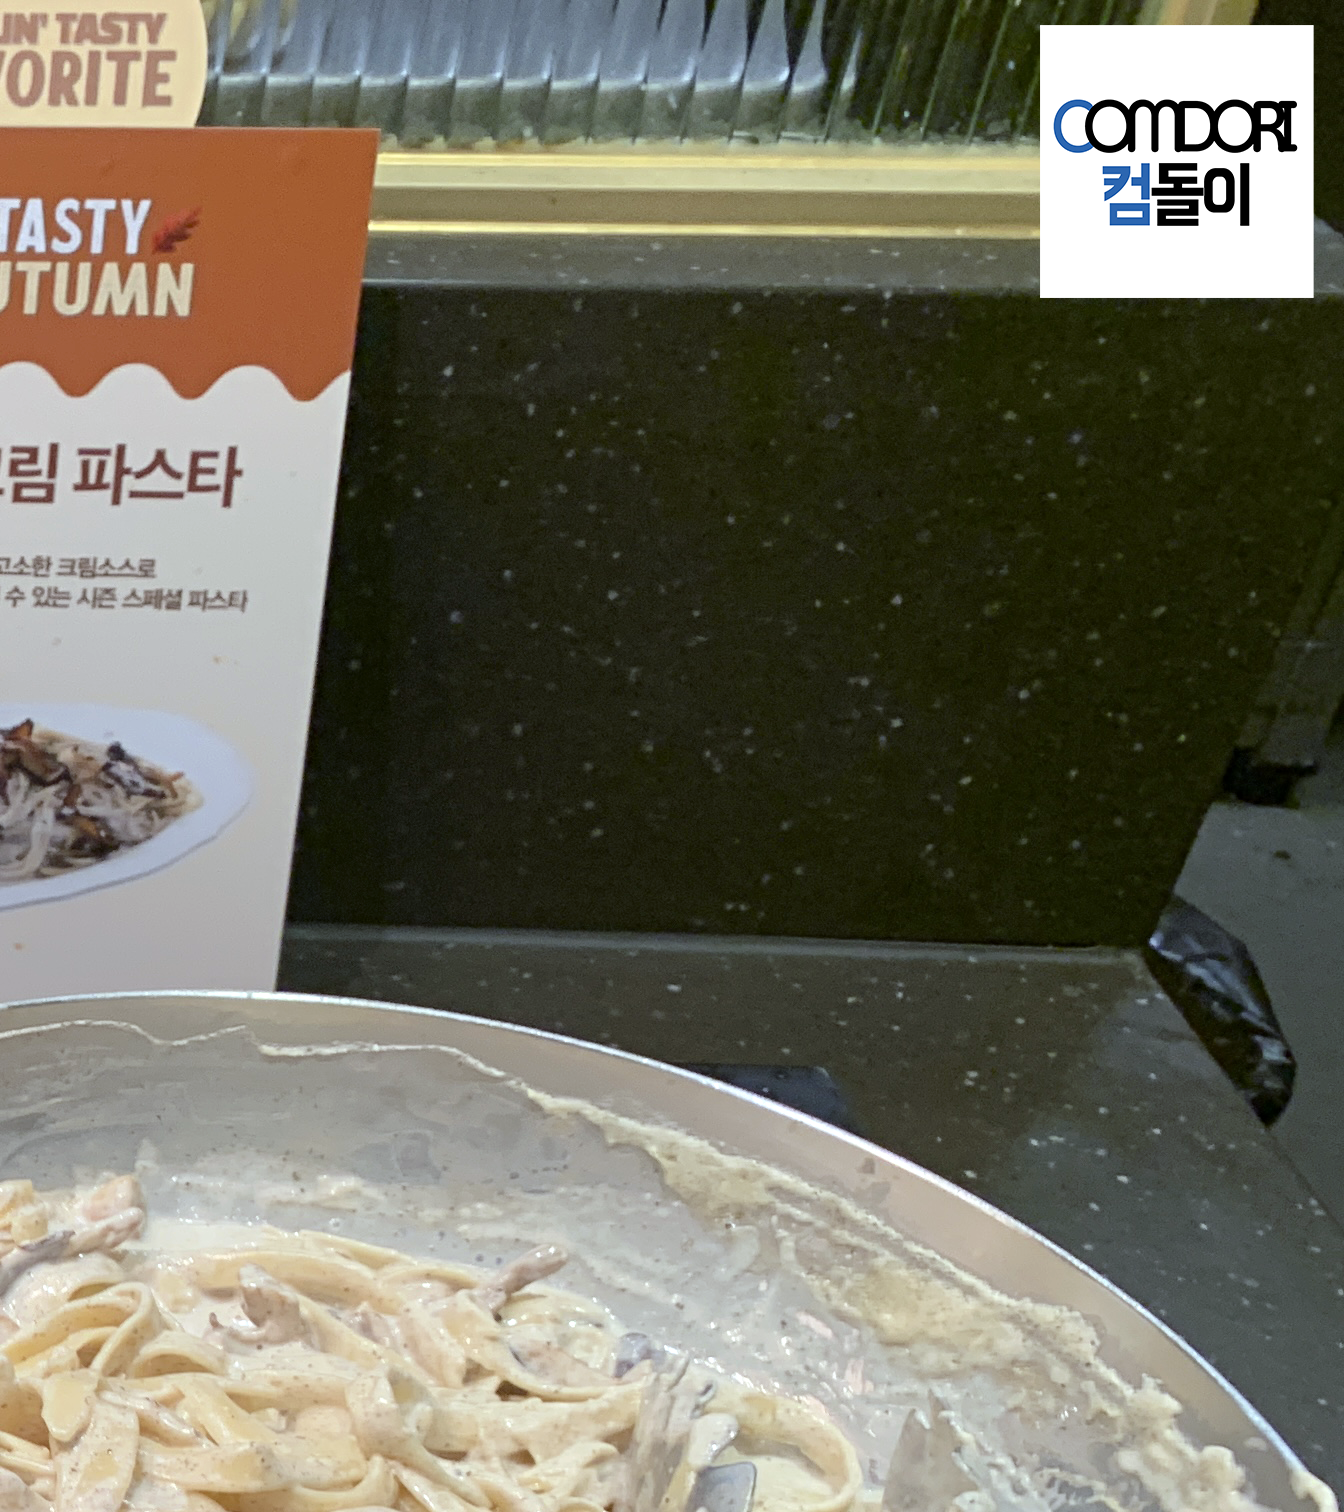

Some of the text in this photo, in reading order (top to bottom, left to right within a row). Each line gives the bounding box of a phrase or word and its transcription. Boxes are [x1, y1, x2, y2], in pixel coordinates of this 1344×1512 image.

[56, 12, 168, 46] TASTY
[73, 443, 244, 508] 파스타
[56, 556, 157, 579] 크림소스로
[5, 586, 26, 608] 수
[32, 586, 72, 609] 있는
[77, 587, 117, 610] 시즌
[121, 588, 183, 611] 스페셜
[187, 588, 249, 613] 파스타
